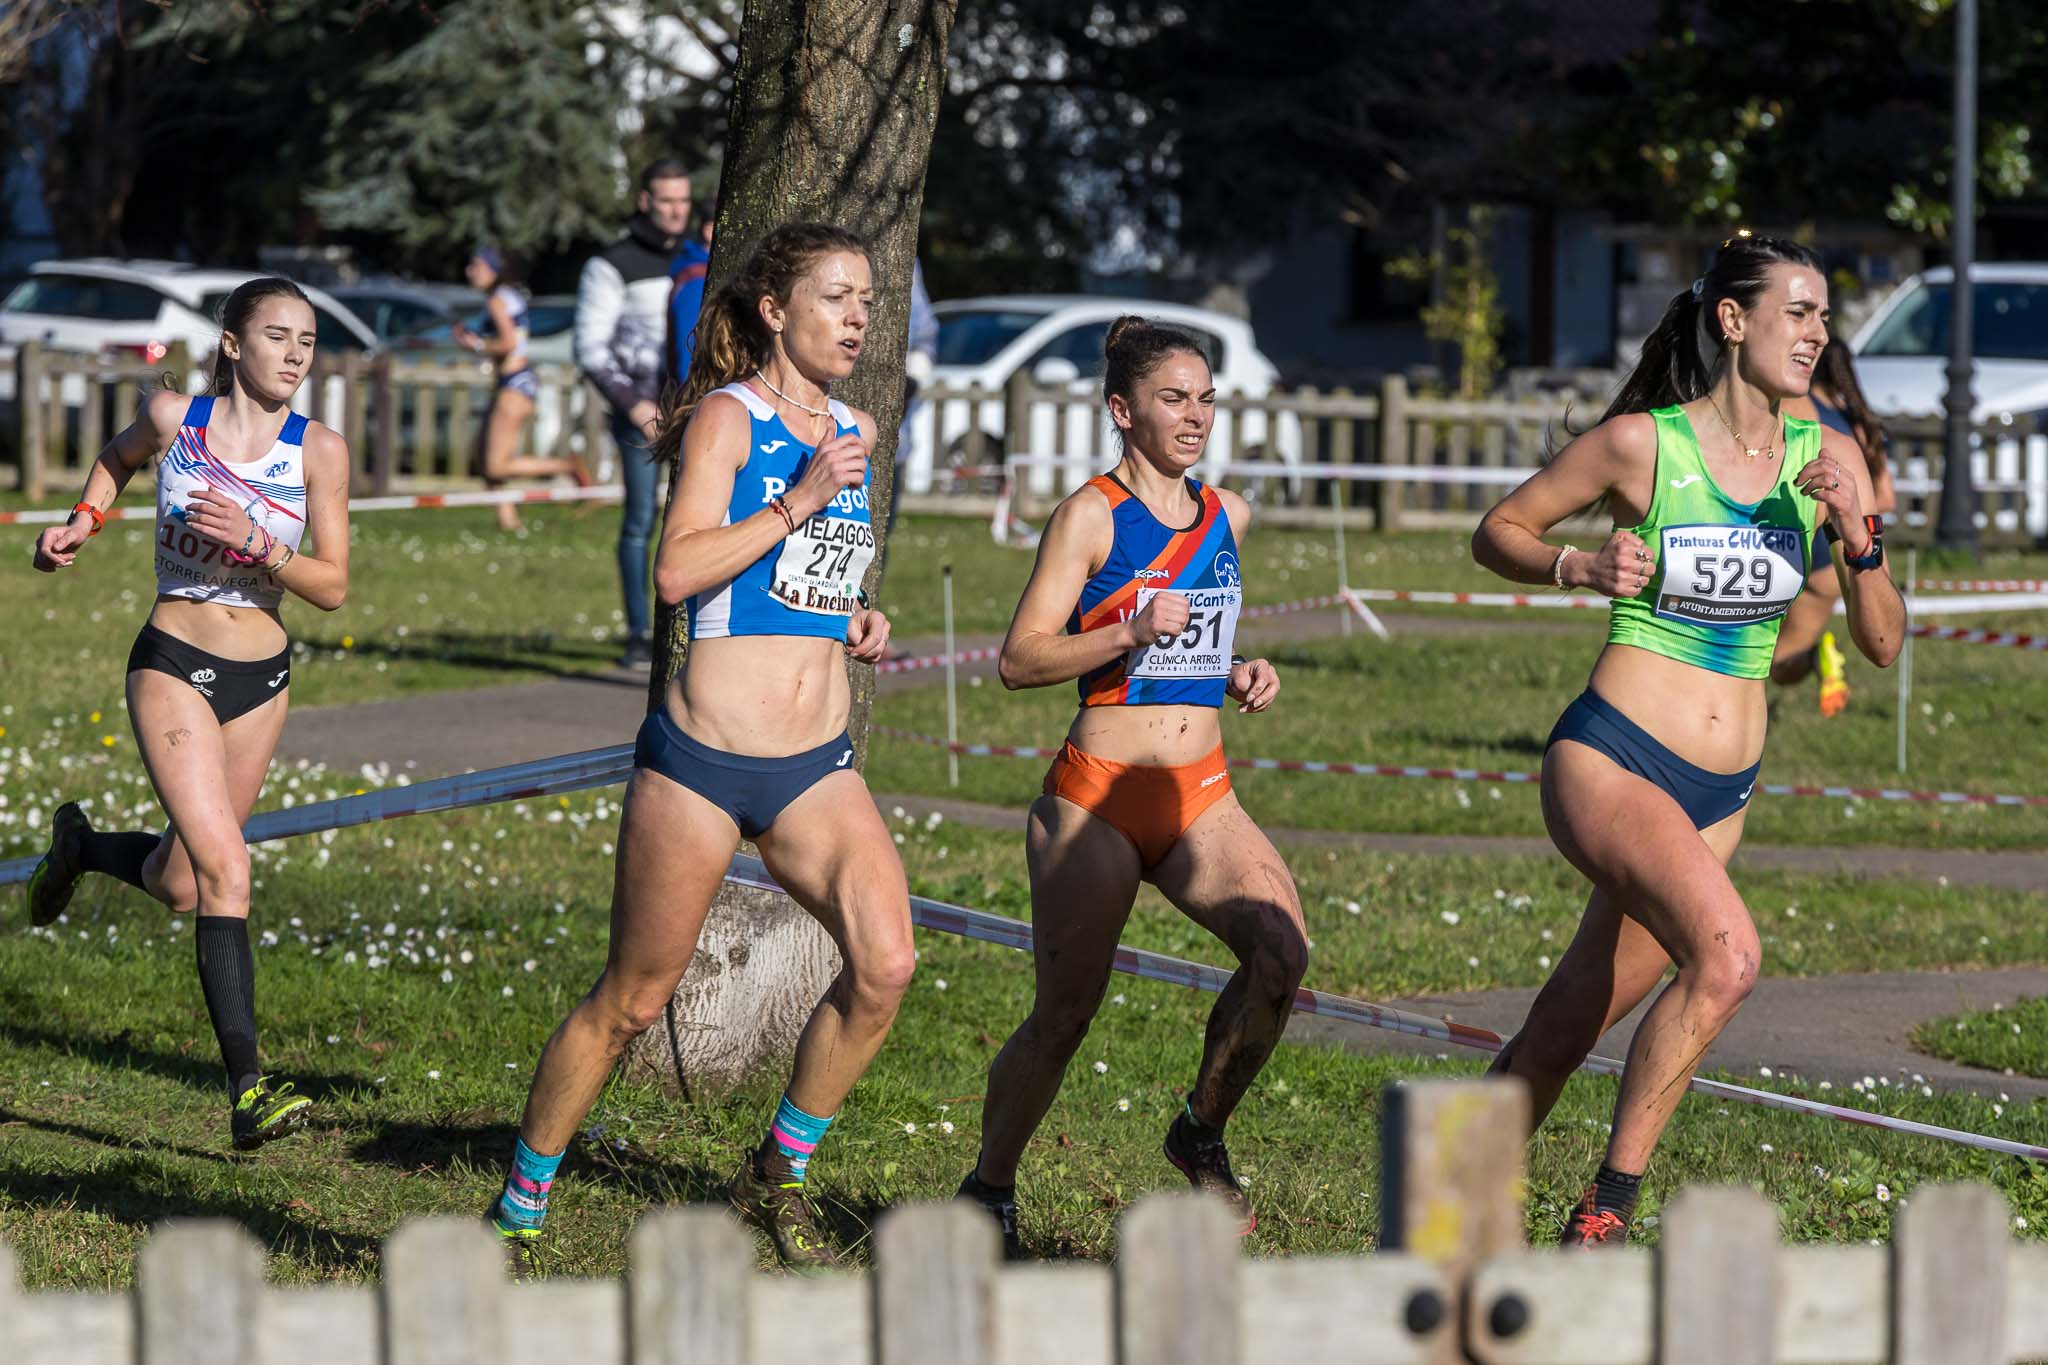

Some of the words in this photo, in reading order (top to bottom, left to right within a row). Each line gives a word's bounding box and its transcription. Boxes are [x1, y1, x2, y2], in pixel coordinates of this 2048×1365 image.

[798, 517, 874, 549] IELAGOS
[1669, 536, 1725, 548] Pinturas
[1728, 529, 1796, 551] CHUCHO
[805, 543, 855, 581] 274
[788, 574, 808, 584] CENTRO
[1691, 554, 1774, 599] 529
[776, 580, 800, 604] La
[1679, 601, 1747, 616] AYUNTAMIENTO
[1747, 607, 1756, 615] de
[1149, 653, 1187, 665] CLÍNICA
[1190, 654, 1221, 665] ARTROS
